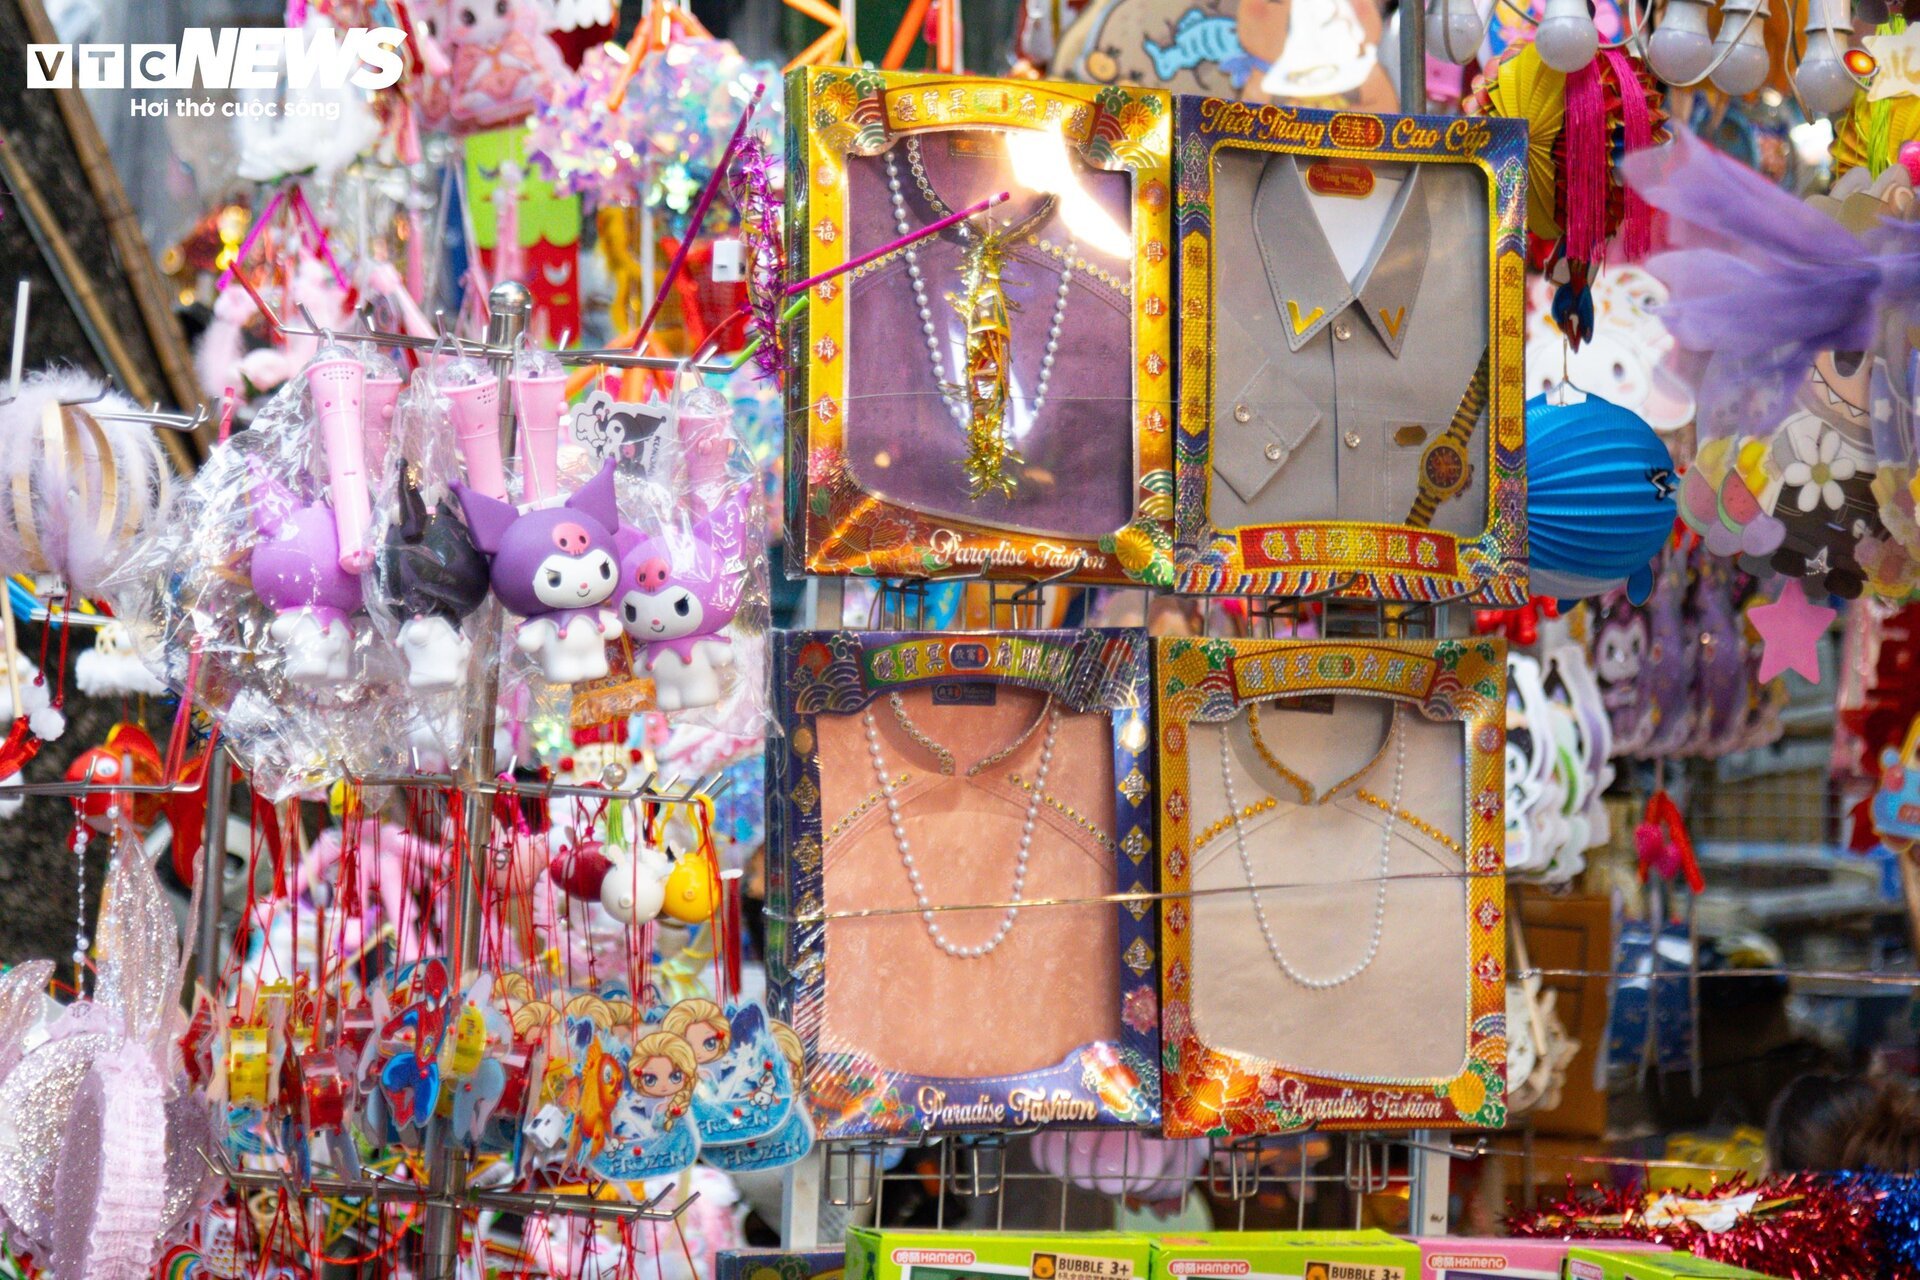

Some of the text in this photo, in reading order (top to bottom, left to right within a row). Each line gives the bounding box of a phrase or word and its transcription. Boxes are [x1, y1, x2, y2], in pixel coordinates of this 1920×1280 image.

[1258, 104, 1327, 149] Trang
[1392, 117, 1441, 149] Cao
[1445, 119, 1491, 157] Cấp
[929, 529, 1026, 567] Paradise
[919, 1086, 1097, 1126] Paradise Fashion
[1279, 1078, 1443, 1120] Paradise Fashion
[610, 1148, 687, 1177] FROZEN
[1058, 1257, 1104, 1274] BUBBLE
[1110, 1261, 1130, 1276] 3+
[1331, 1266, 1401, 1280] BUBBLE 3+
